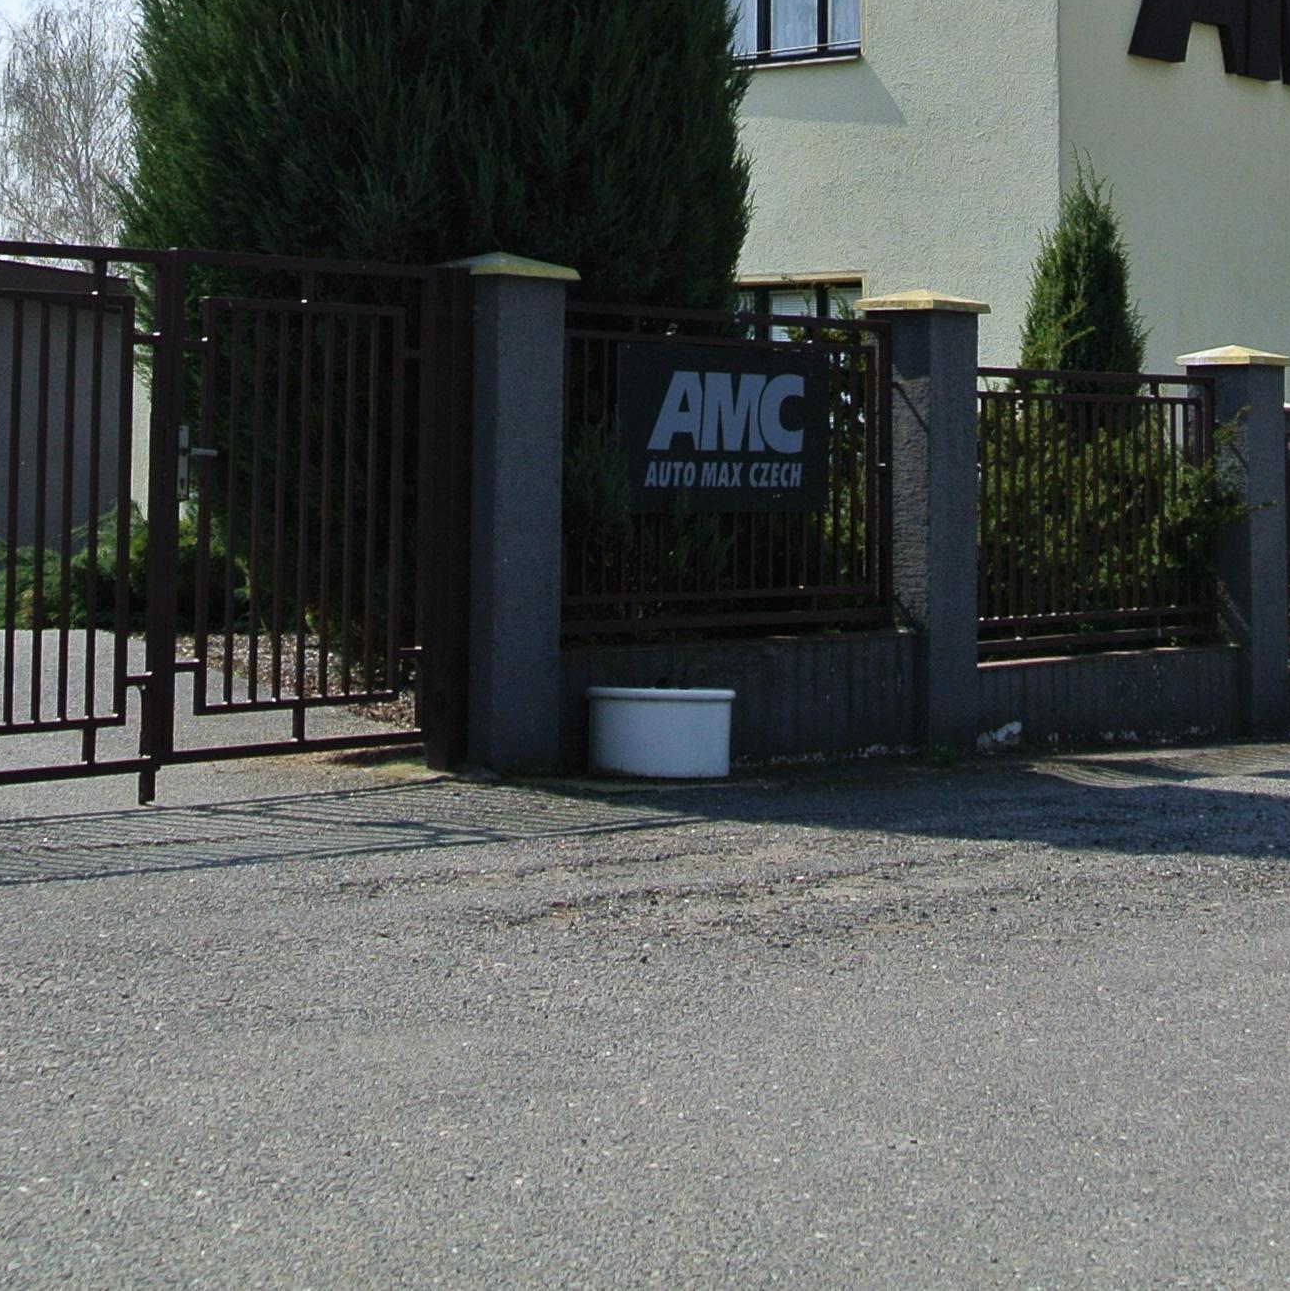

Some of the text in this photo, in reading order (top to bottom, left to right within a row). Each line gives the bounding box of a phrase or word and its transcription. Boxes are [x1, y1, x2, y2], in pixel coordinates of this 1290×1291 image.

[648, 371, 805, 454] AMC
[644, 461, 802, 488] AUTO MAX CZECH
